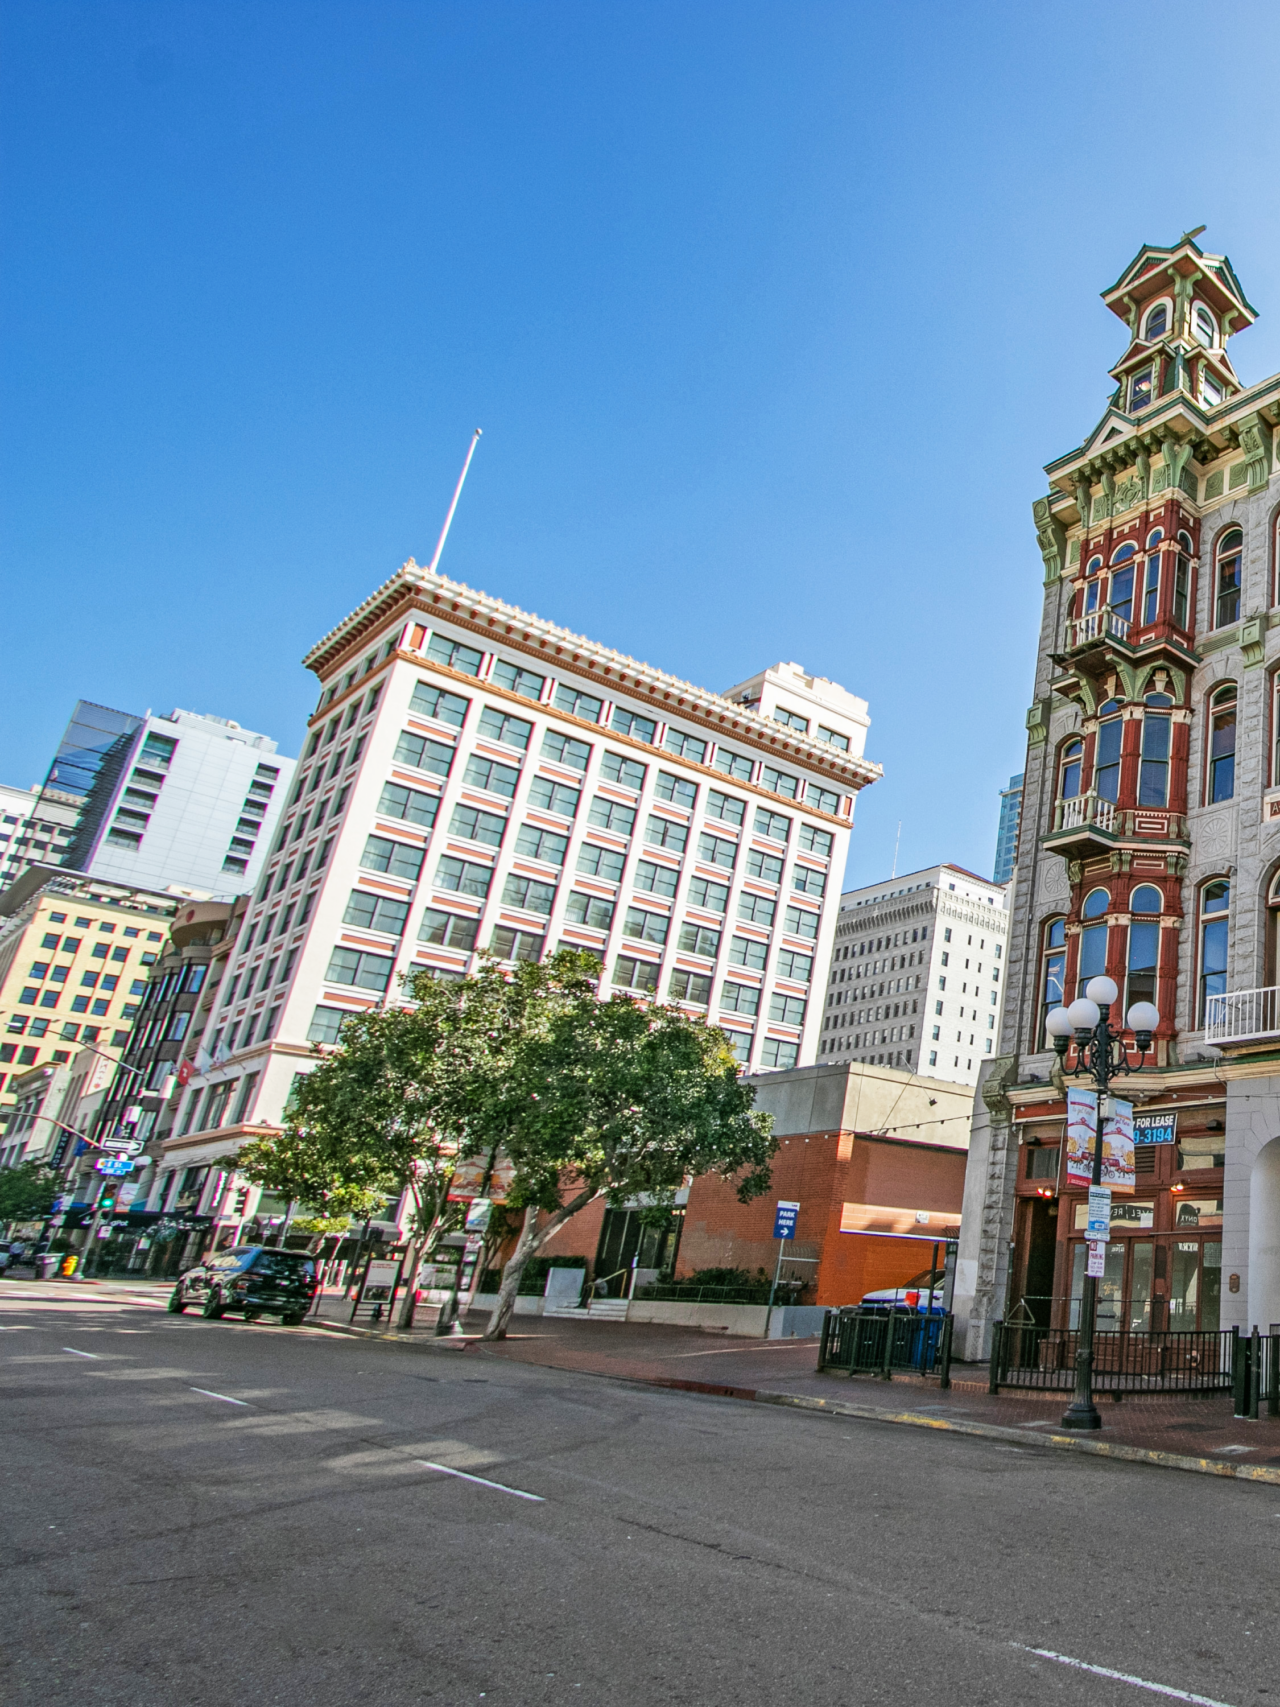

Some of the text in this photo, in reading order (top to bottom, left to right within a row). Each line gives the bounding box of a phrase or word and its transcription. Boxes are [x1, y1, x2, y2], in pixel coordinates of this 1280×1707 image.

[1136, 1115, 1174, 1128] FOR LEASE
[779, 1210, 796, 1218] PARK
[778, 1219, 794, 1227] HERE
